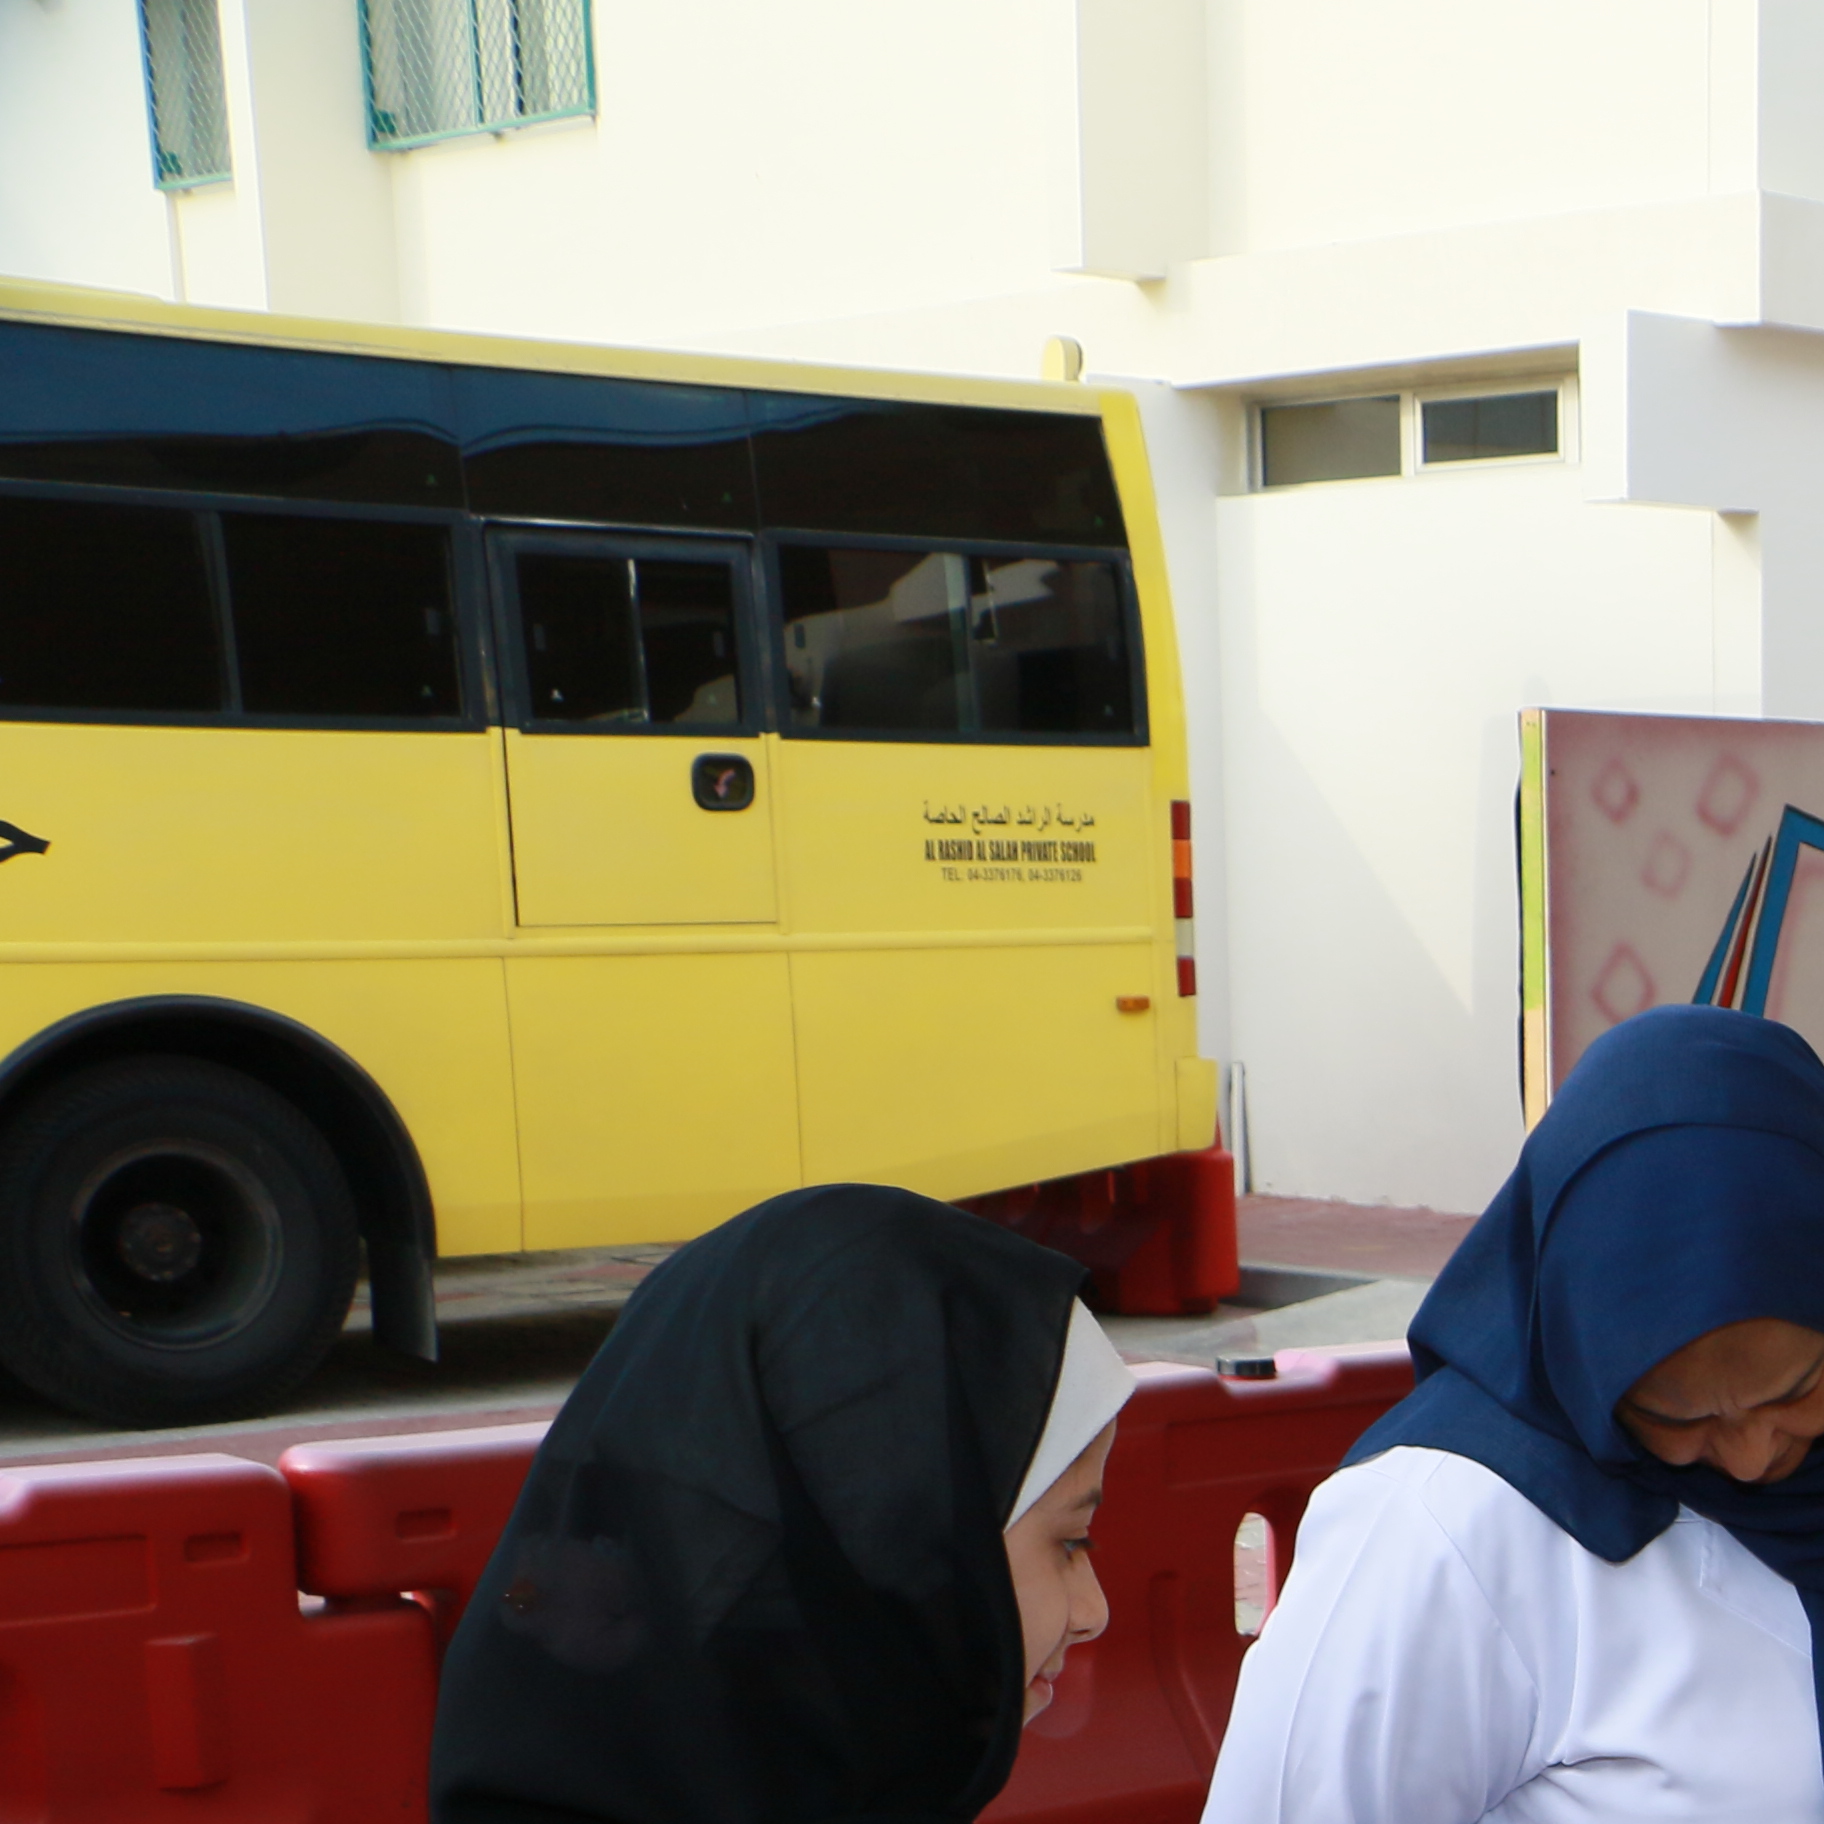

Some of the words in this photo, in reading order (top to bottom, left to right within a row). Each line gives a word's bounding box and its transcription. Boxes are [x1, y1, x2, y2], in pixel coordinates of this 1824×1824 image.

[972, 804, 1010, 835] الصالح
[1056, 803, 1095, 832] مدرسة
[925, 839, 936, 861] AL
[938, 839, 973, 861] RASHID
[976, 840, 987, 861] AL
[1021, 840, 1058, 862] PRIVATE
[1060, 841, 1096, 863] SCHOOL
